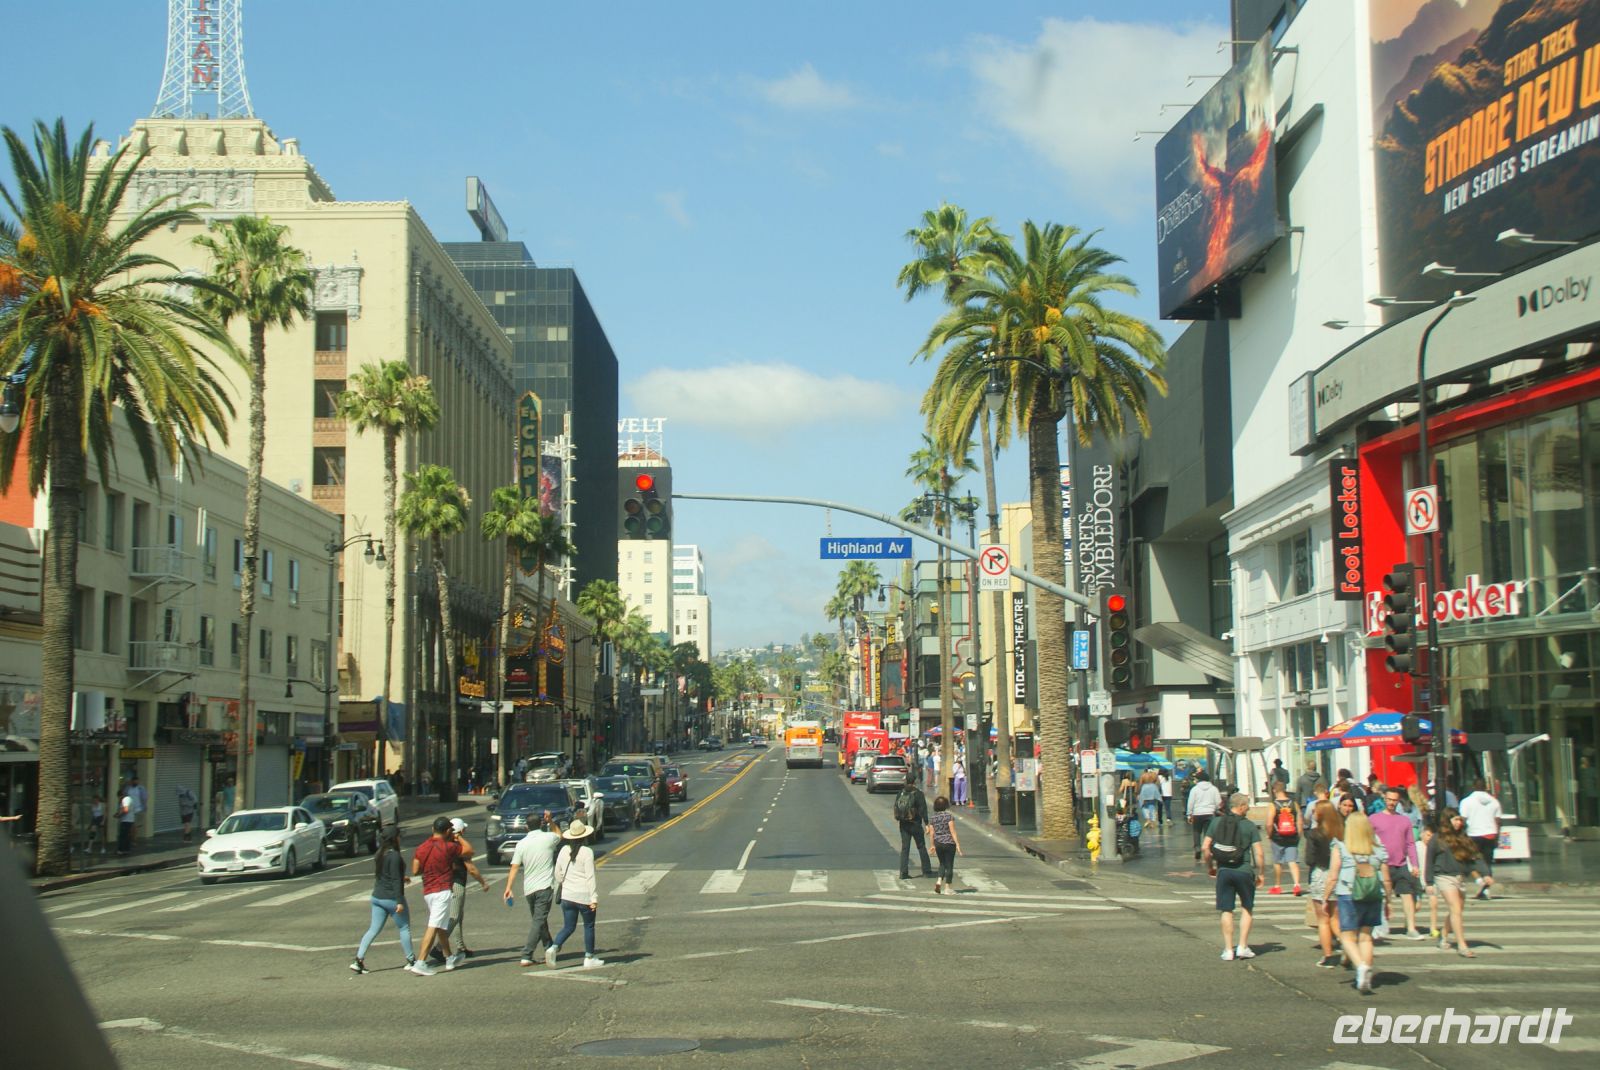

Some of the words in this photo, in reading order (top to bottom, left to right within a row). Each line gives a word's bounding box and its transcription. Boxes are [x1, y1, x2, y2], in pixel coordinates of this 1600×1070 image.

[1503, 43, 1538, 87] STAR
[1541, 18, 1580, 64] TREK
[1424, 92, 1515, 195] STRANGE
[1515, 55, 1578, 143] NEW
[1444, 181, 1469, 214] NEW
[1471, 155, 1517, 198] SERIES
[1540, 276, 1593, 309] Dolby
[519, 405, 537, 421] EL
[1325, 378, 1344, 403] Dolby
[1062, 490, 1070, 508] PLAY
[1337, 466, 1359, 539] Locker
[827, 542, 883, 557] Highland
[888, 541, 904, 553] Av
[1078, 513, 1095, 584] SECRETS
[1093, 464, 1115, 590] UMBLEDORE
[1340, 545, 1361, 593] Foot
[1014, 598, 1024, 645] THEATRE
[857, 737, 882, 749] TMZ
